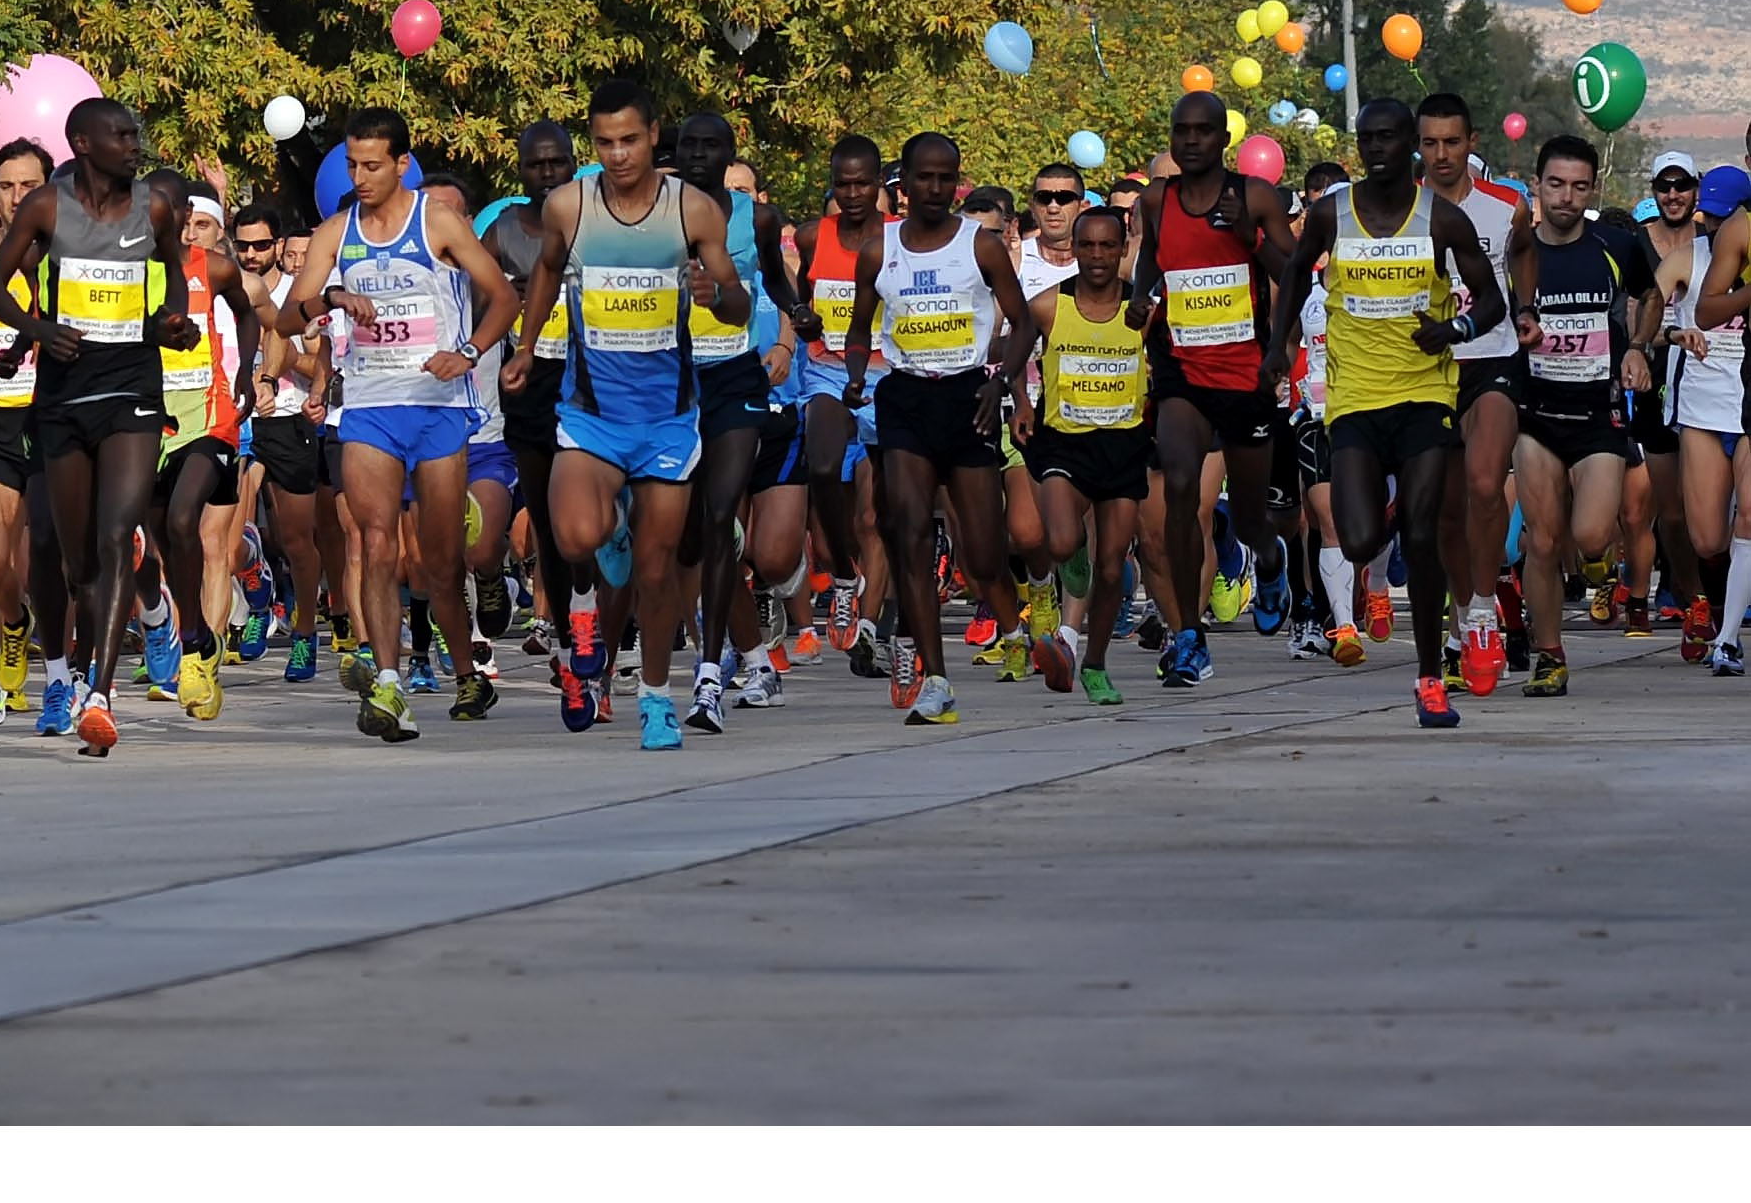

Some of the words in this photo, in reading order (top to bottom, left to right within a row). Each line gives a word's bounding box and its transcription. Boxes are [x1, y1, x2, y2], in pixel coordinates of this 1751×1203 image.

[912, 269, 937, 287] ICE
[1345, 266, 1426, 282] KIPNGETICH
[356, 273, 415, 294] HELLAS
[89, 289, 122, 304] BETT
[604, 296, 657, 313] LAARISS
[1184, 293, 1232, 311] KISANG
[371, 321, 411, 344] 353
[895, 317, 968, 335] KASSAHOUN
[1066, 343, 1096, 355] team
[1548, 333, 1590, 353] 257
[1071, 380, 1126, 393] MELSAMO
